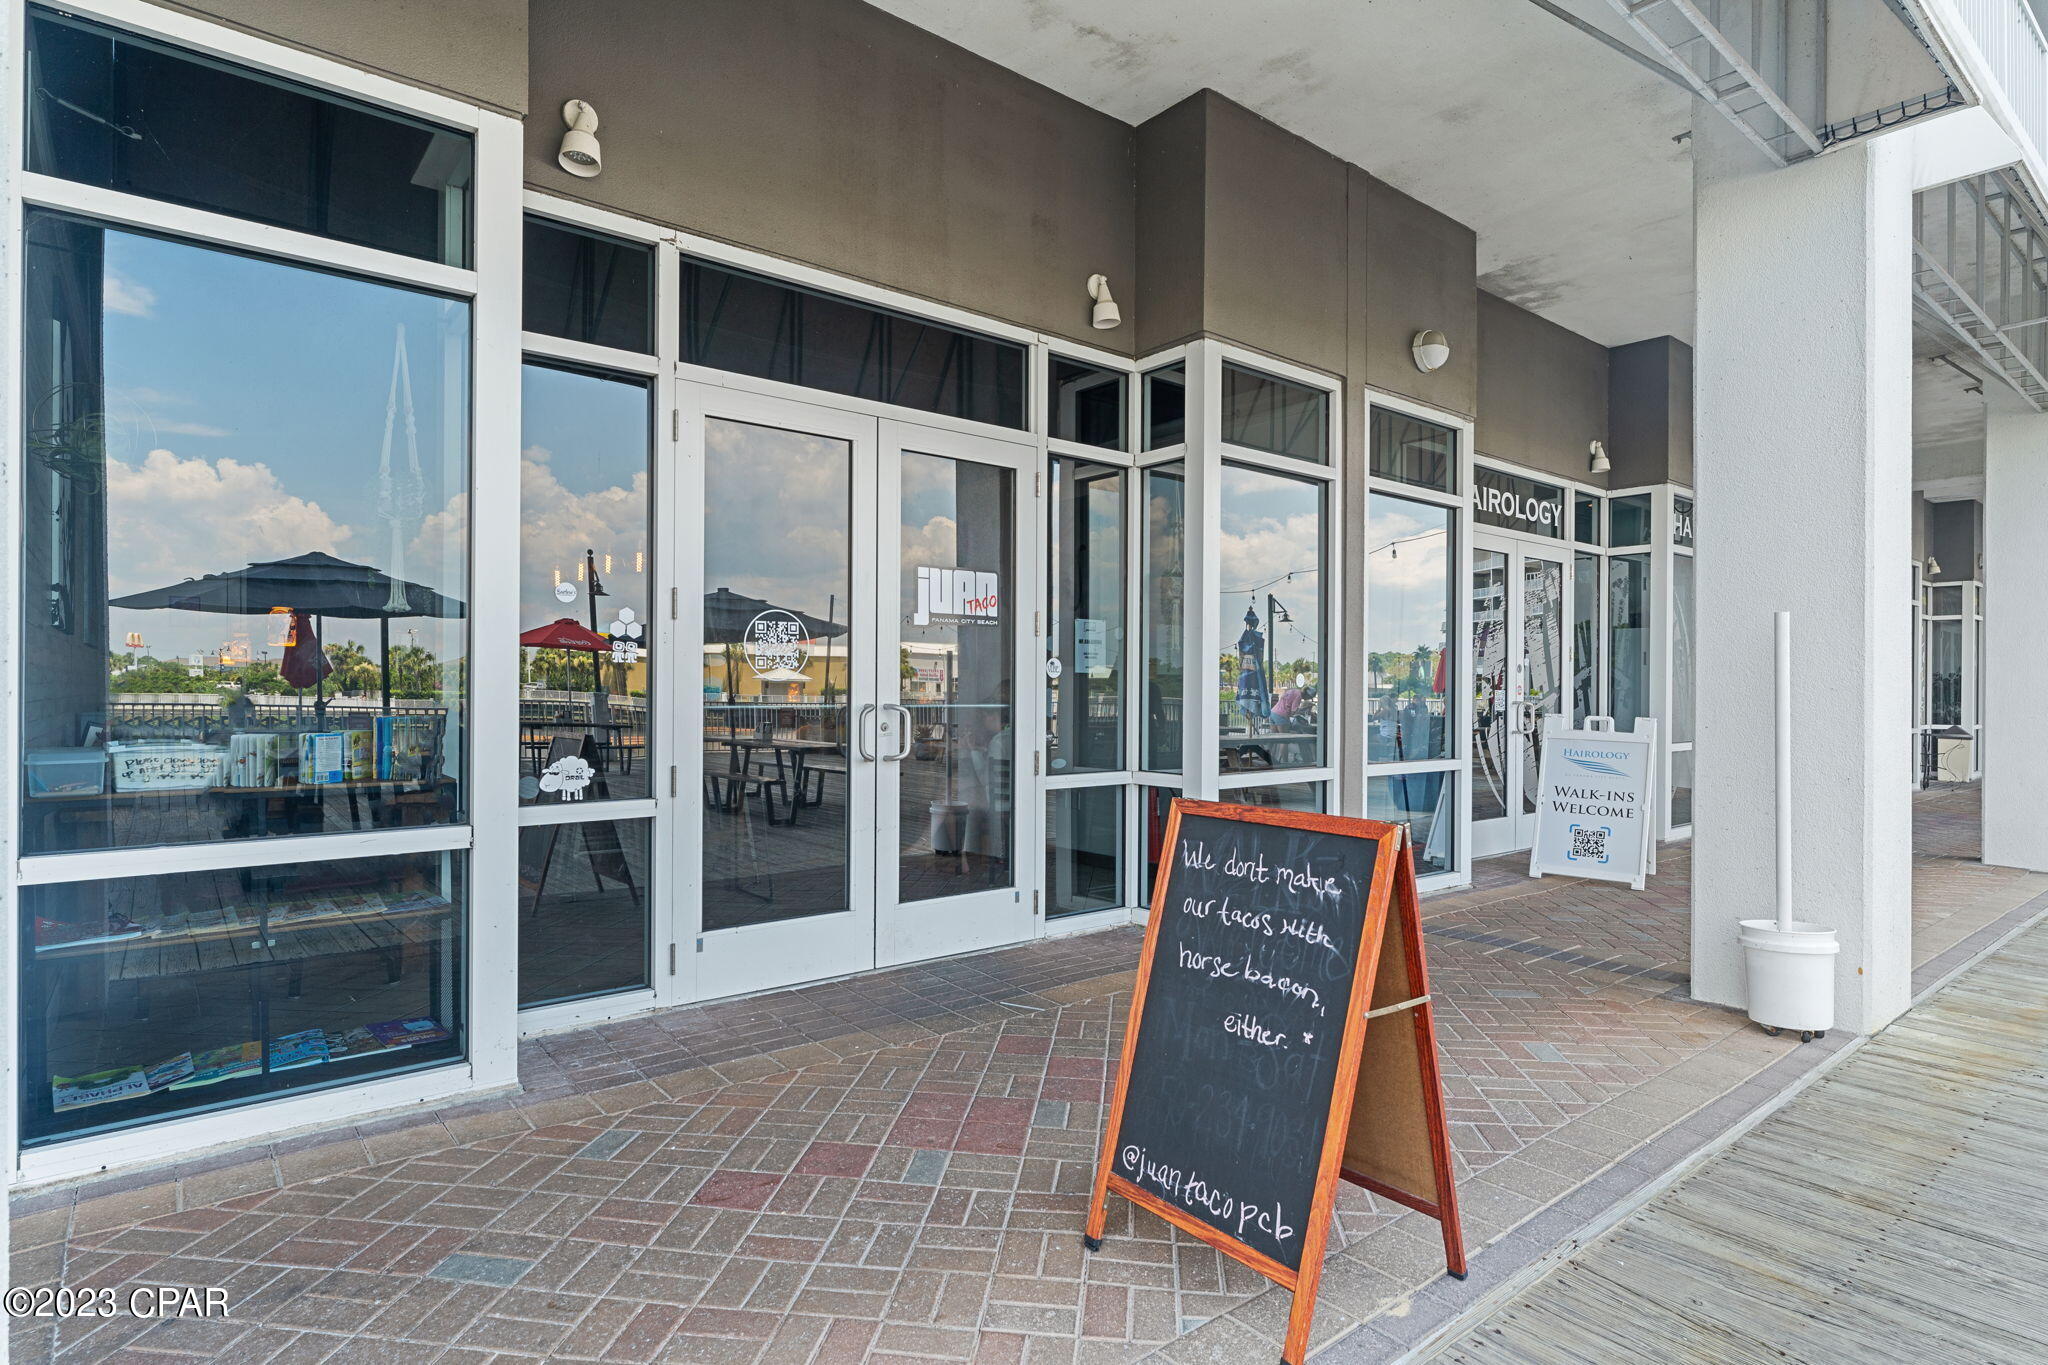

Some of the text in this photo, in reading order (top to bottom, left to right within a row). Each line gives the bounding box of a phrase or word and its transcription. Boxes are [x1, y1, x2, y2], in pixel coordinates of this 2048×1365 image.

[966, 595, 997, 614] TACO
[1563, 747, 1631, 760] HAIROLOGY
[1554, 785, 1635, 803] WALK-INS
[1552, 801, 1634, 819] WELCOME
[1183, 838, 1217, 870] We
[1183, 896, 1216, 918] our
[1217, 897, 1273, 936] tacos
[1179, 941, 1240, 978] horse
